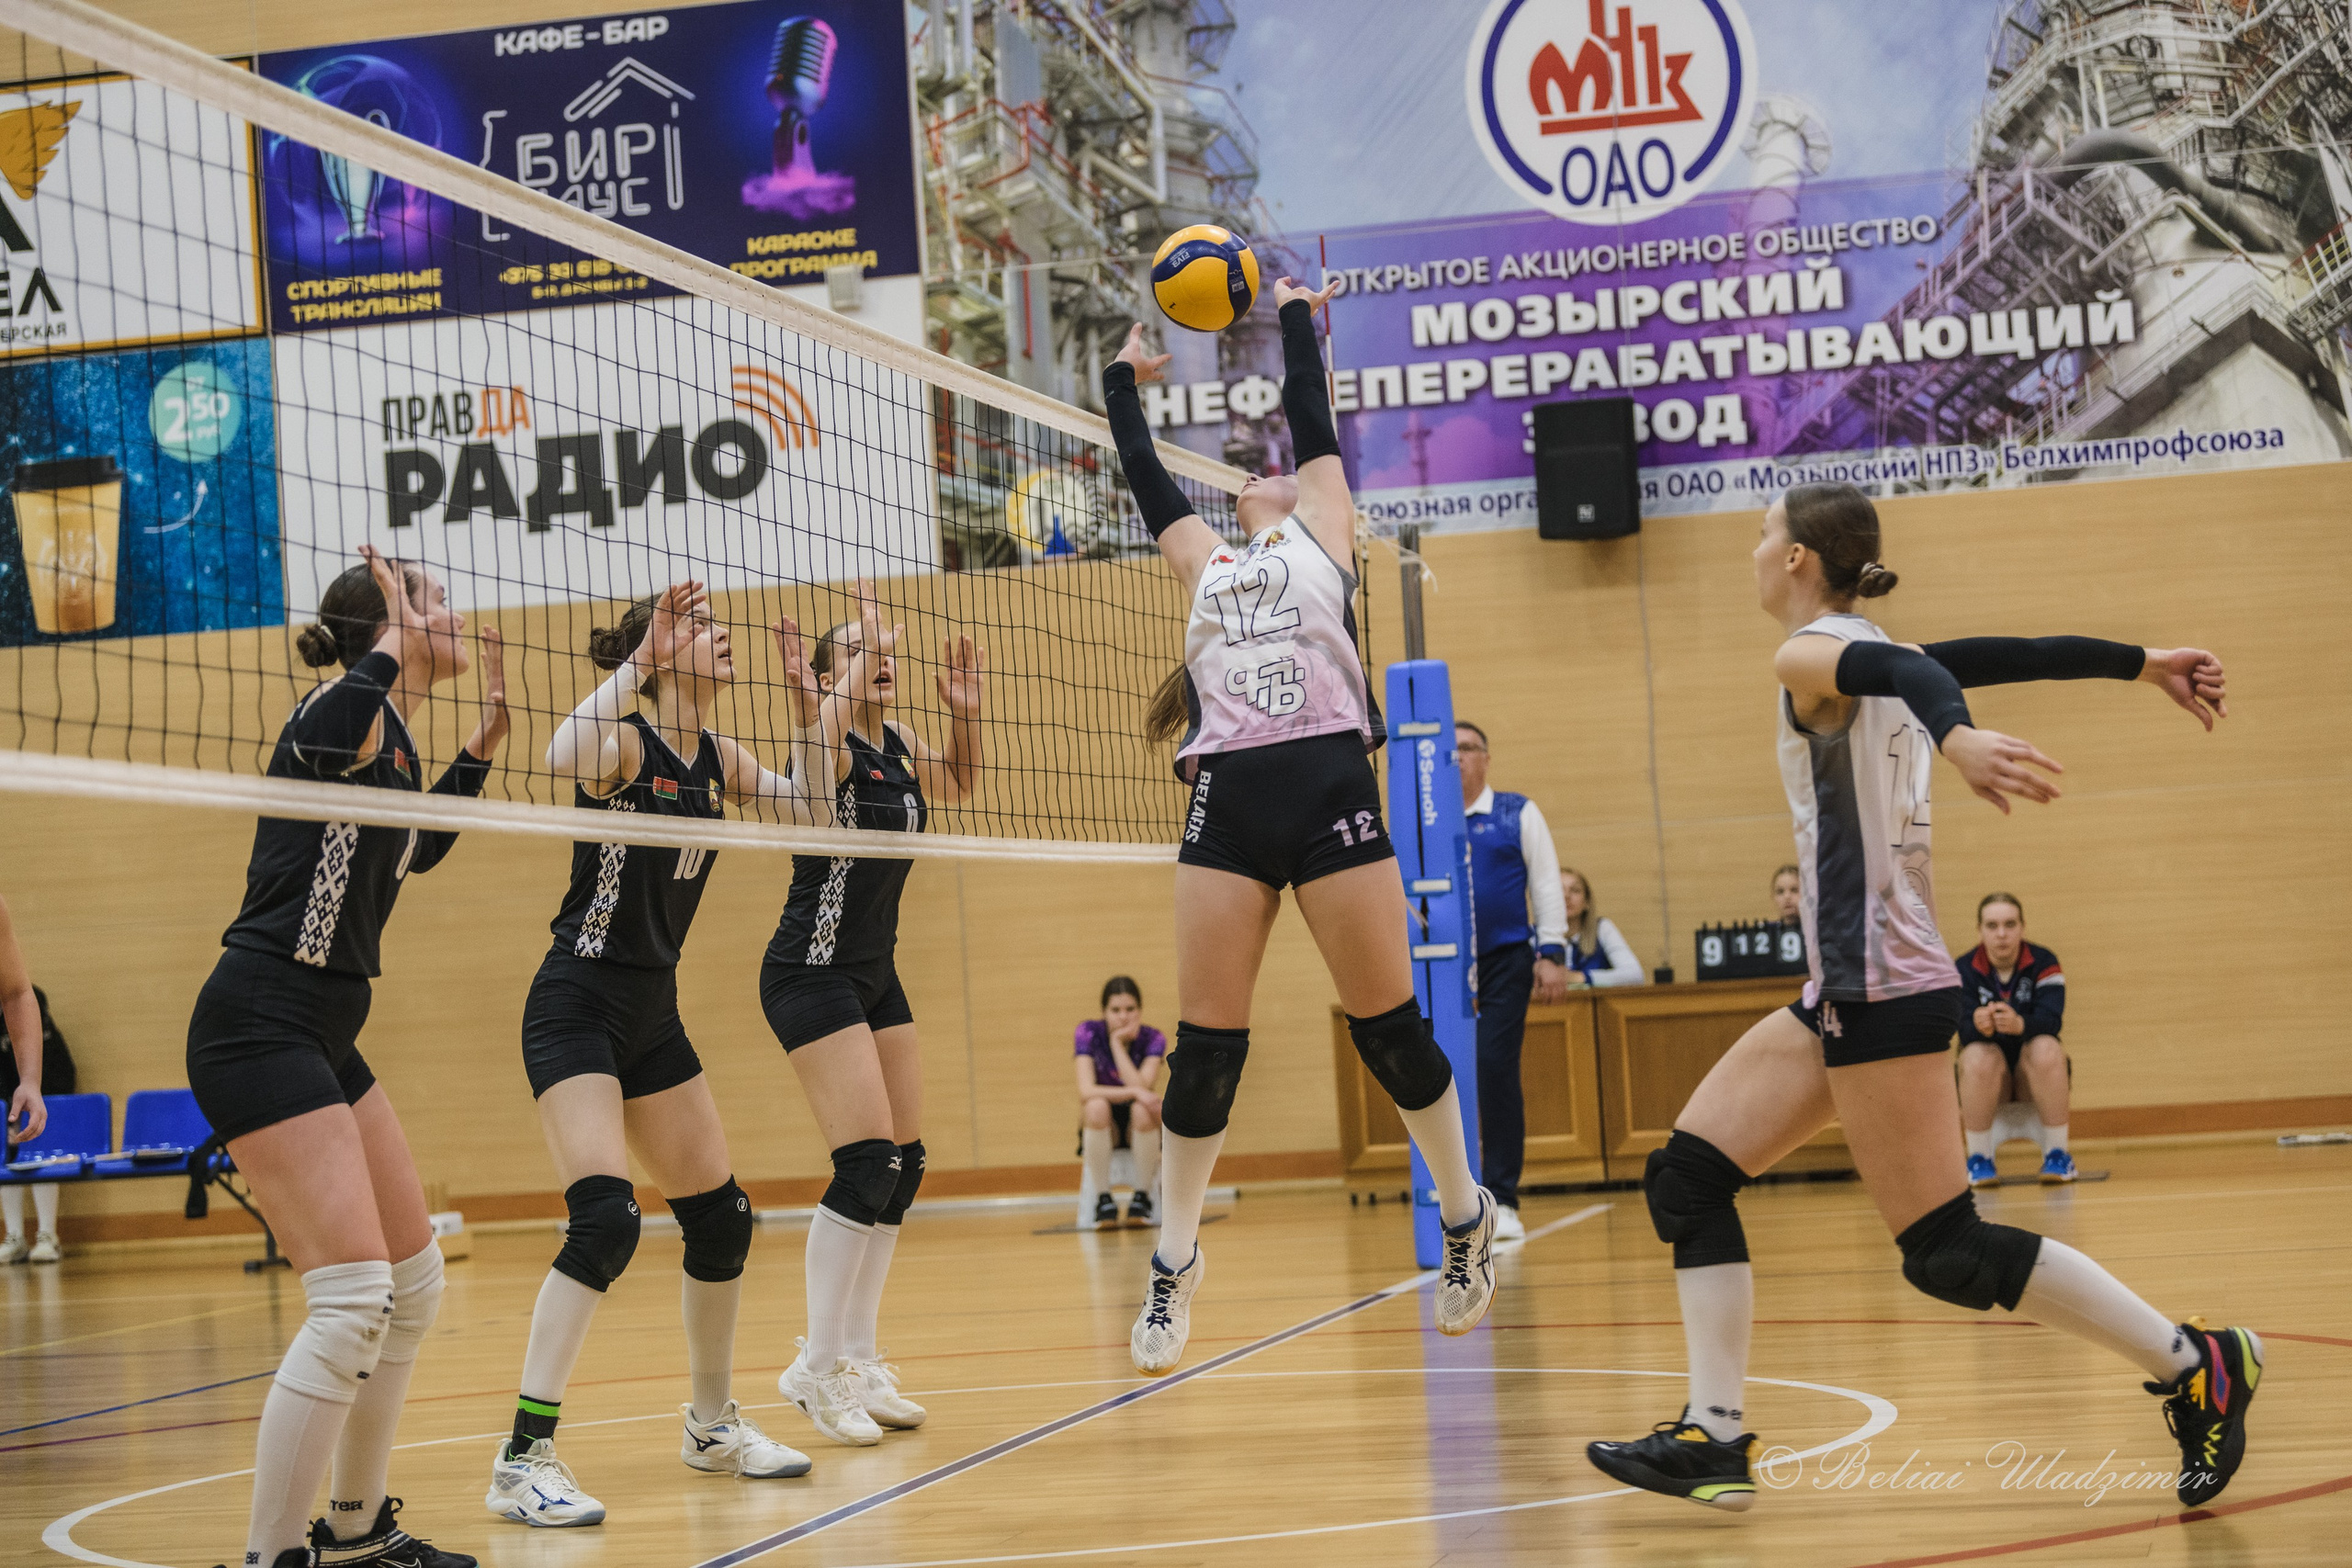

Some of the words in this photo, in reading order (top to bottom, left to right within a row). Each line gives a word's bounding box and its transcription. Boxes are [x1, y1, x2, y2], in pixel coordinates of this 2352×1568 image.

[494, 16, 669, 57] КАФЕ-БАР
[516, 123, 656, 186] БИР
[1561, 140, 1674, 207] ОАО
[537, 176, 651, 219] АУС
[746, 228, 857, 256] КАРАОКЕ
[1325, 256, 1490, 297] ОТКРЫТОЕ
[1498, 231, 1745, 281] АКЦИОНЕРНОЕ
[1756, 214, 1938, 258] ОБЩЕСТВО
[287, 268, 442, 300] СПОРТИВНЫЕ
[1410, 258, 1844, 347] МОЗЫРСКИЙ
[1147, 289, 2135, 426] НЕФЕПЕРЕРАБАТЫВАЮЩИЙ
[382, 386, 531, 441] ПРАВДА
[385, 419, 768, 533] РАДИО
[1668, 469, 1724, 497] ОАО
[2005, 427, 2285, 471] Белхимпрофсоюза
[1204, 554, 1300, 647] 12
[1332, 810, 1378, 847] 12
[1702, 936, 1724, 967] 9
[1780, 931, 1802, 963] 9
